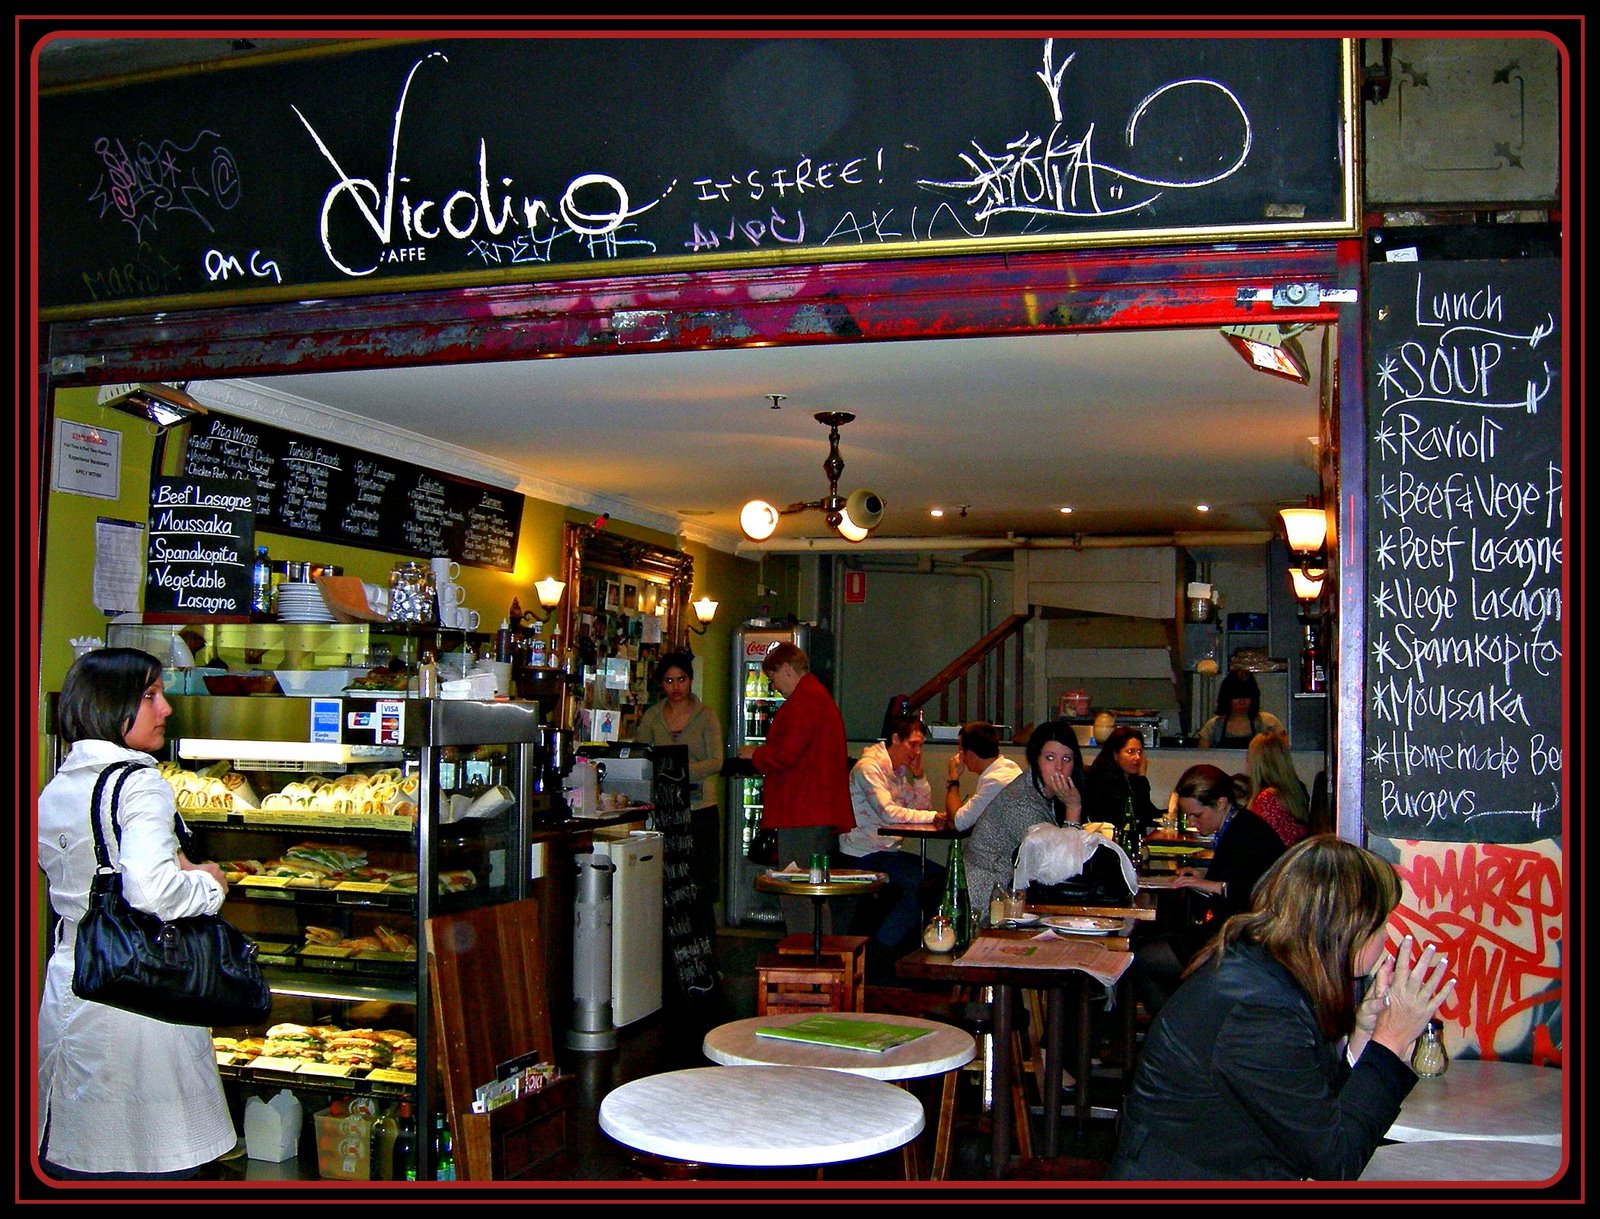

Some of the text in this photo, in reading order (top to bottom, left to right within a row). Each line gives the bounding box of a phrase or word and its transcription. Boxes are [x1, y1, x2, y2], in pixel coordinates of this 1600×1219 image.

[1416, 272, 1502, 327] Lunch
[1400, 341, 1502, 399] SOUP
[211, 420, 259, 445] Pita Wraps
[1398, 413, 1503, 465] Ravioli
[157, 485, 193, 506] Beef
[195, 485, 252, 512] Lasagne
[158, 509, 232, 535] Moussaka
[1399, 470, 1464, 524] Beef
[1474, 473, 1541, 531] Vege
[155, 537, 238, 566] Spanakopita
[1399, 525, 1466, 583] Beef
[155, 564, 226, 591] Vegetable
[177, 588, 236, 614] Lasagne
[1394, 578, 1458, 632] Vege
[1389, 675, 1531, 732] Moussaka
[1391, 730, 1520, 779] Homemade
[1380, 779, 1476, 827] Burgers
